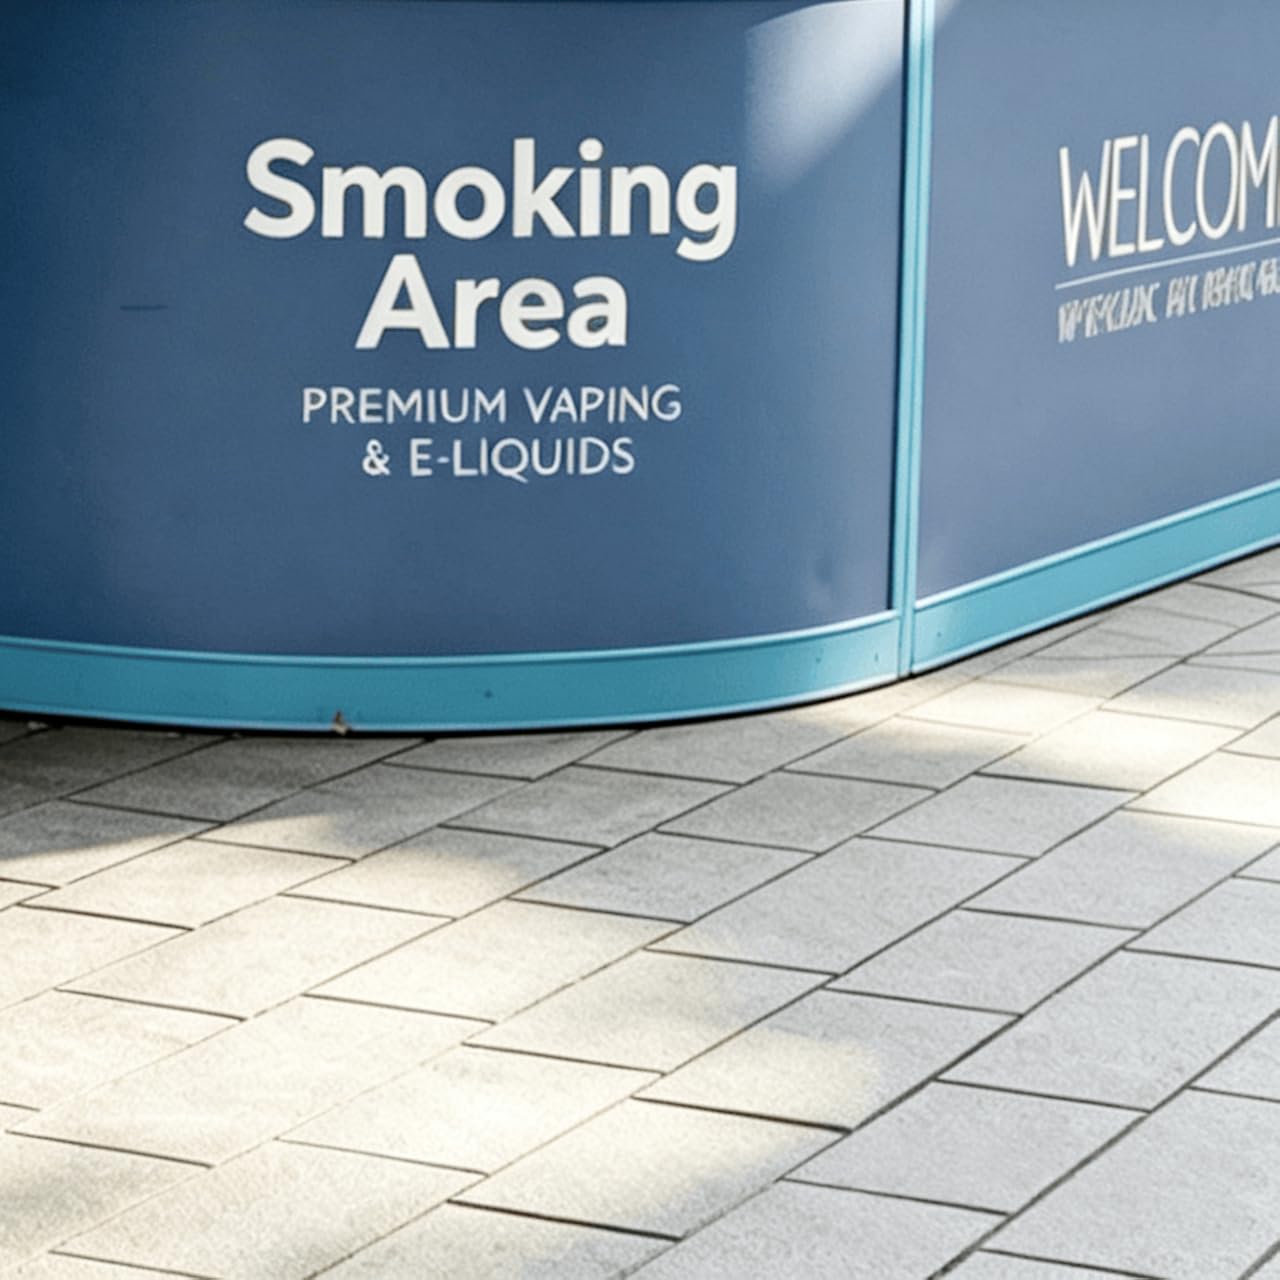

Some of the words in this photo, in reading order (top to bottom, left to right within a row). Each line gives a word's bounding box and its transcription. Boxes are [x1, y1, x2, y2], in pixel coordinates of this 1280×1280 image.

[243, 137, 738, 262] Smoking
[1058, 114, 1280, 268] WELCOM
[355, 253, 628, 350] Area
[302, 387, 507, 425] PREMIUM
[523, 383, 682, 424] VAPING
[362, 438, 391, 477] &
[409, 436, 636, 483] E-LIQUIDS
